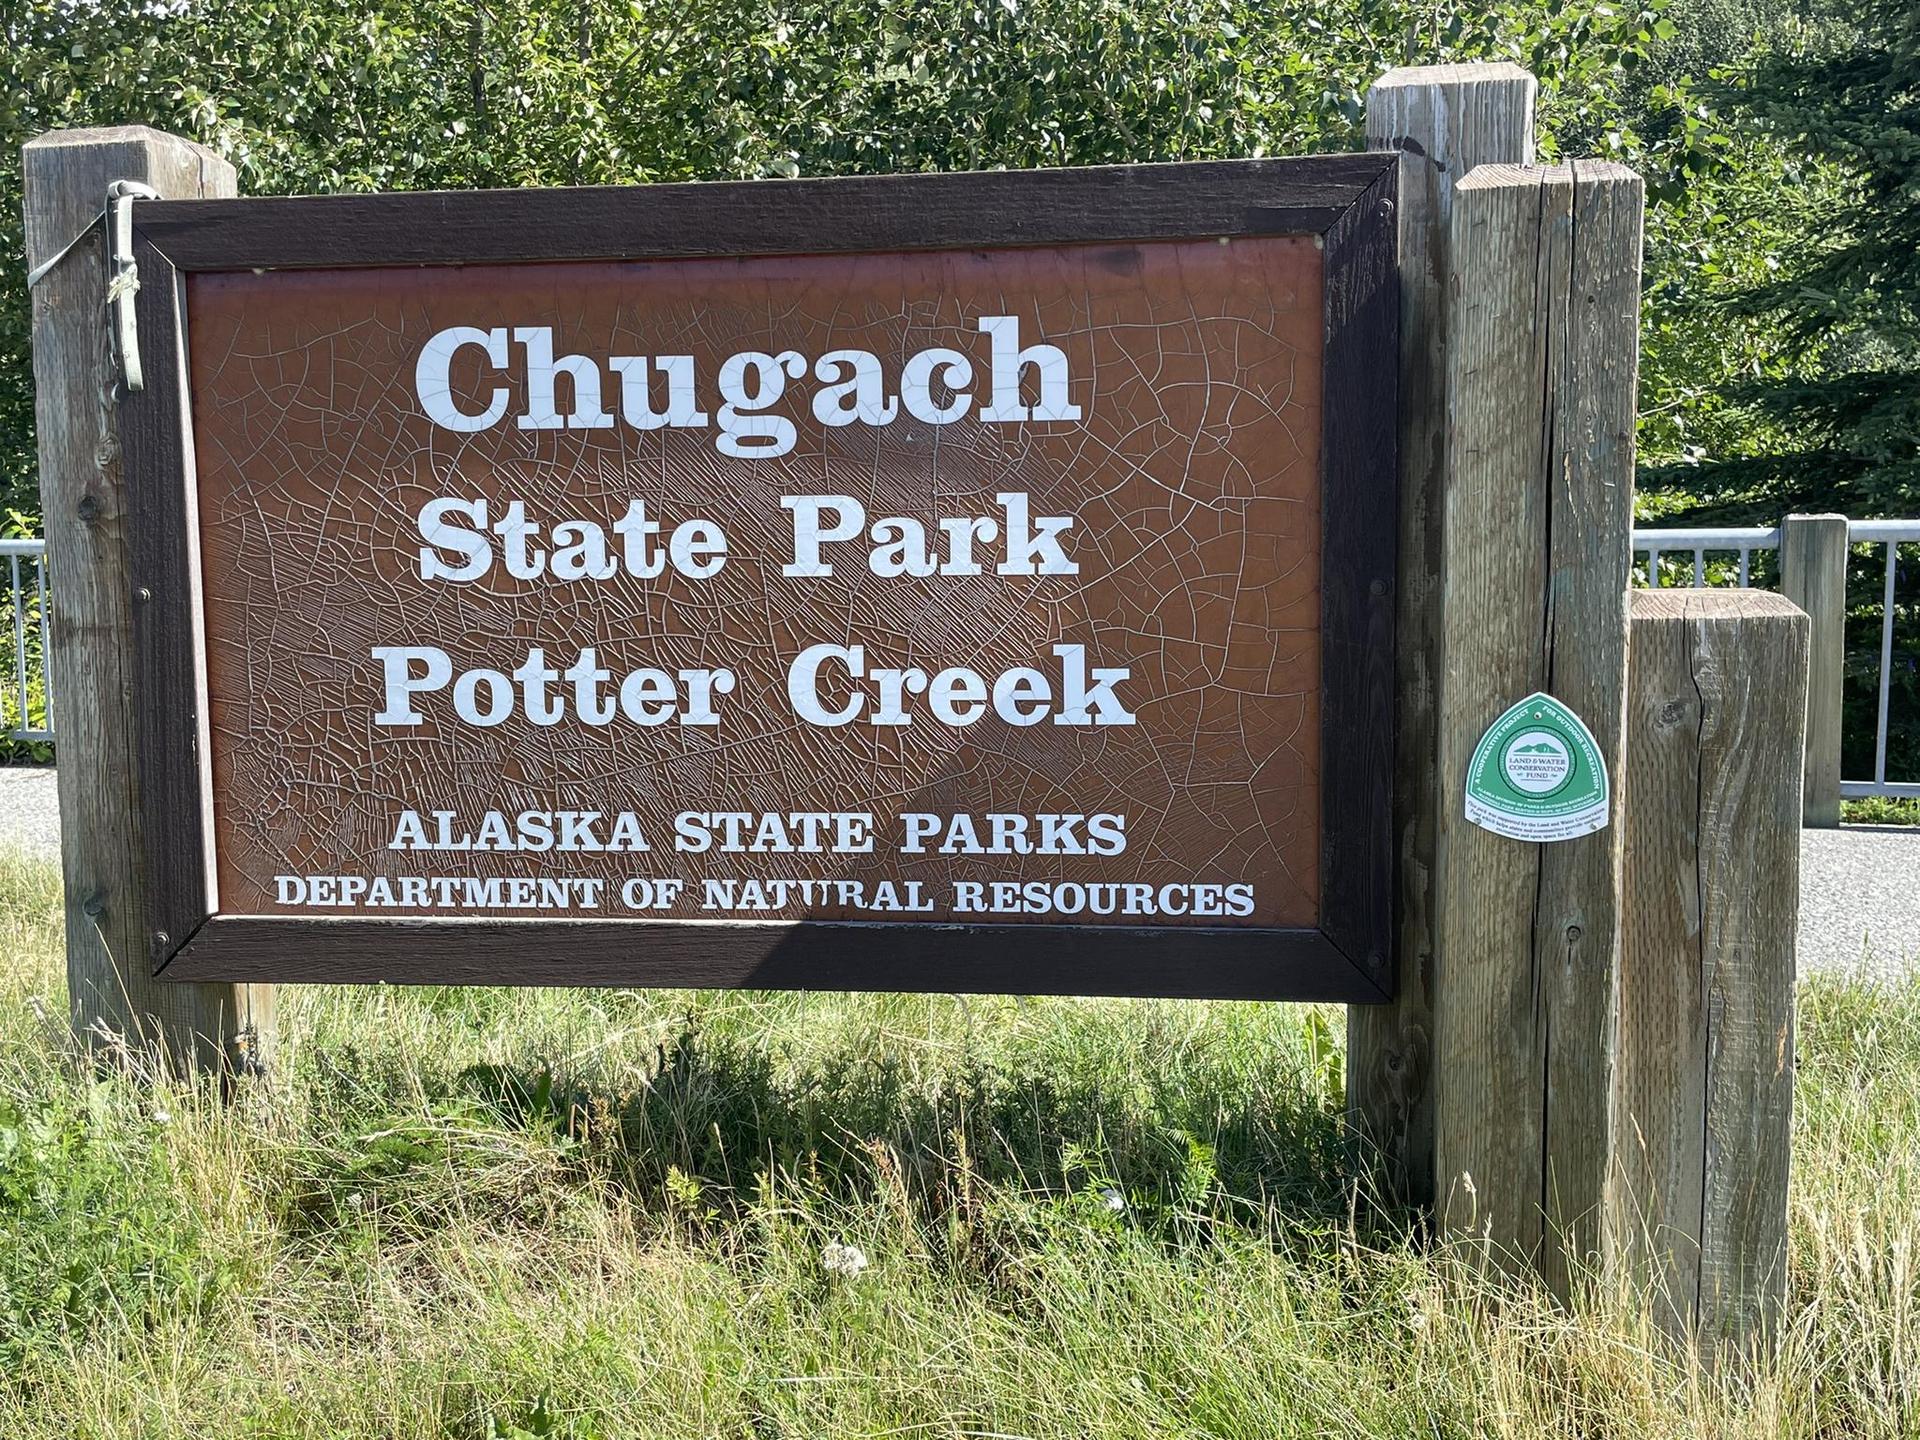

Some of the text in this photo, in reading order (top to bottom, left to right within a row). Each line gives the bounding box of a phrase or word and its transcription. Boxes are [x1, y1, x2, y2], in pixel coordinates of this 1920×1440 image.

[416, 315, 1082, 459] Chugach
[419, 492, 1080, 583] State Park
[371, 643, 1137, 727] Potter Creek
[1477, 731, 1502, 778] COOPERATIVE
[1500, 708, 1529, 732] PROJECT
[1542, 705, 1557, 718] FOR
[1556, 715, 1584, 746] OUTDOOR
[1581, 743, 1600, 790] RECREATION
[388, 809, 1127, 856] ALASKA STATE PARKS
[274, 876, 1256, 917] DEPARTMENT OF NATURAL RESOURCES
